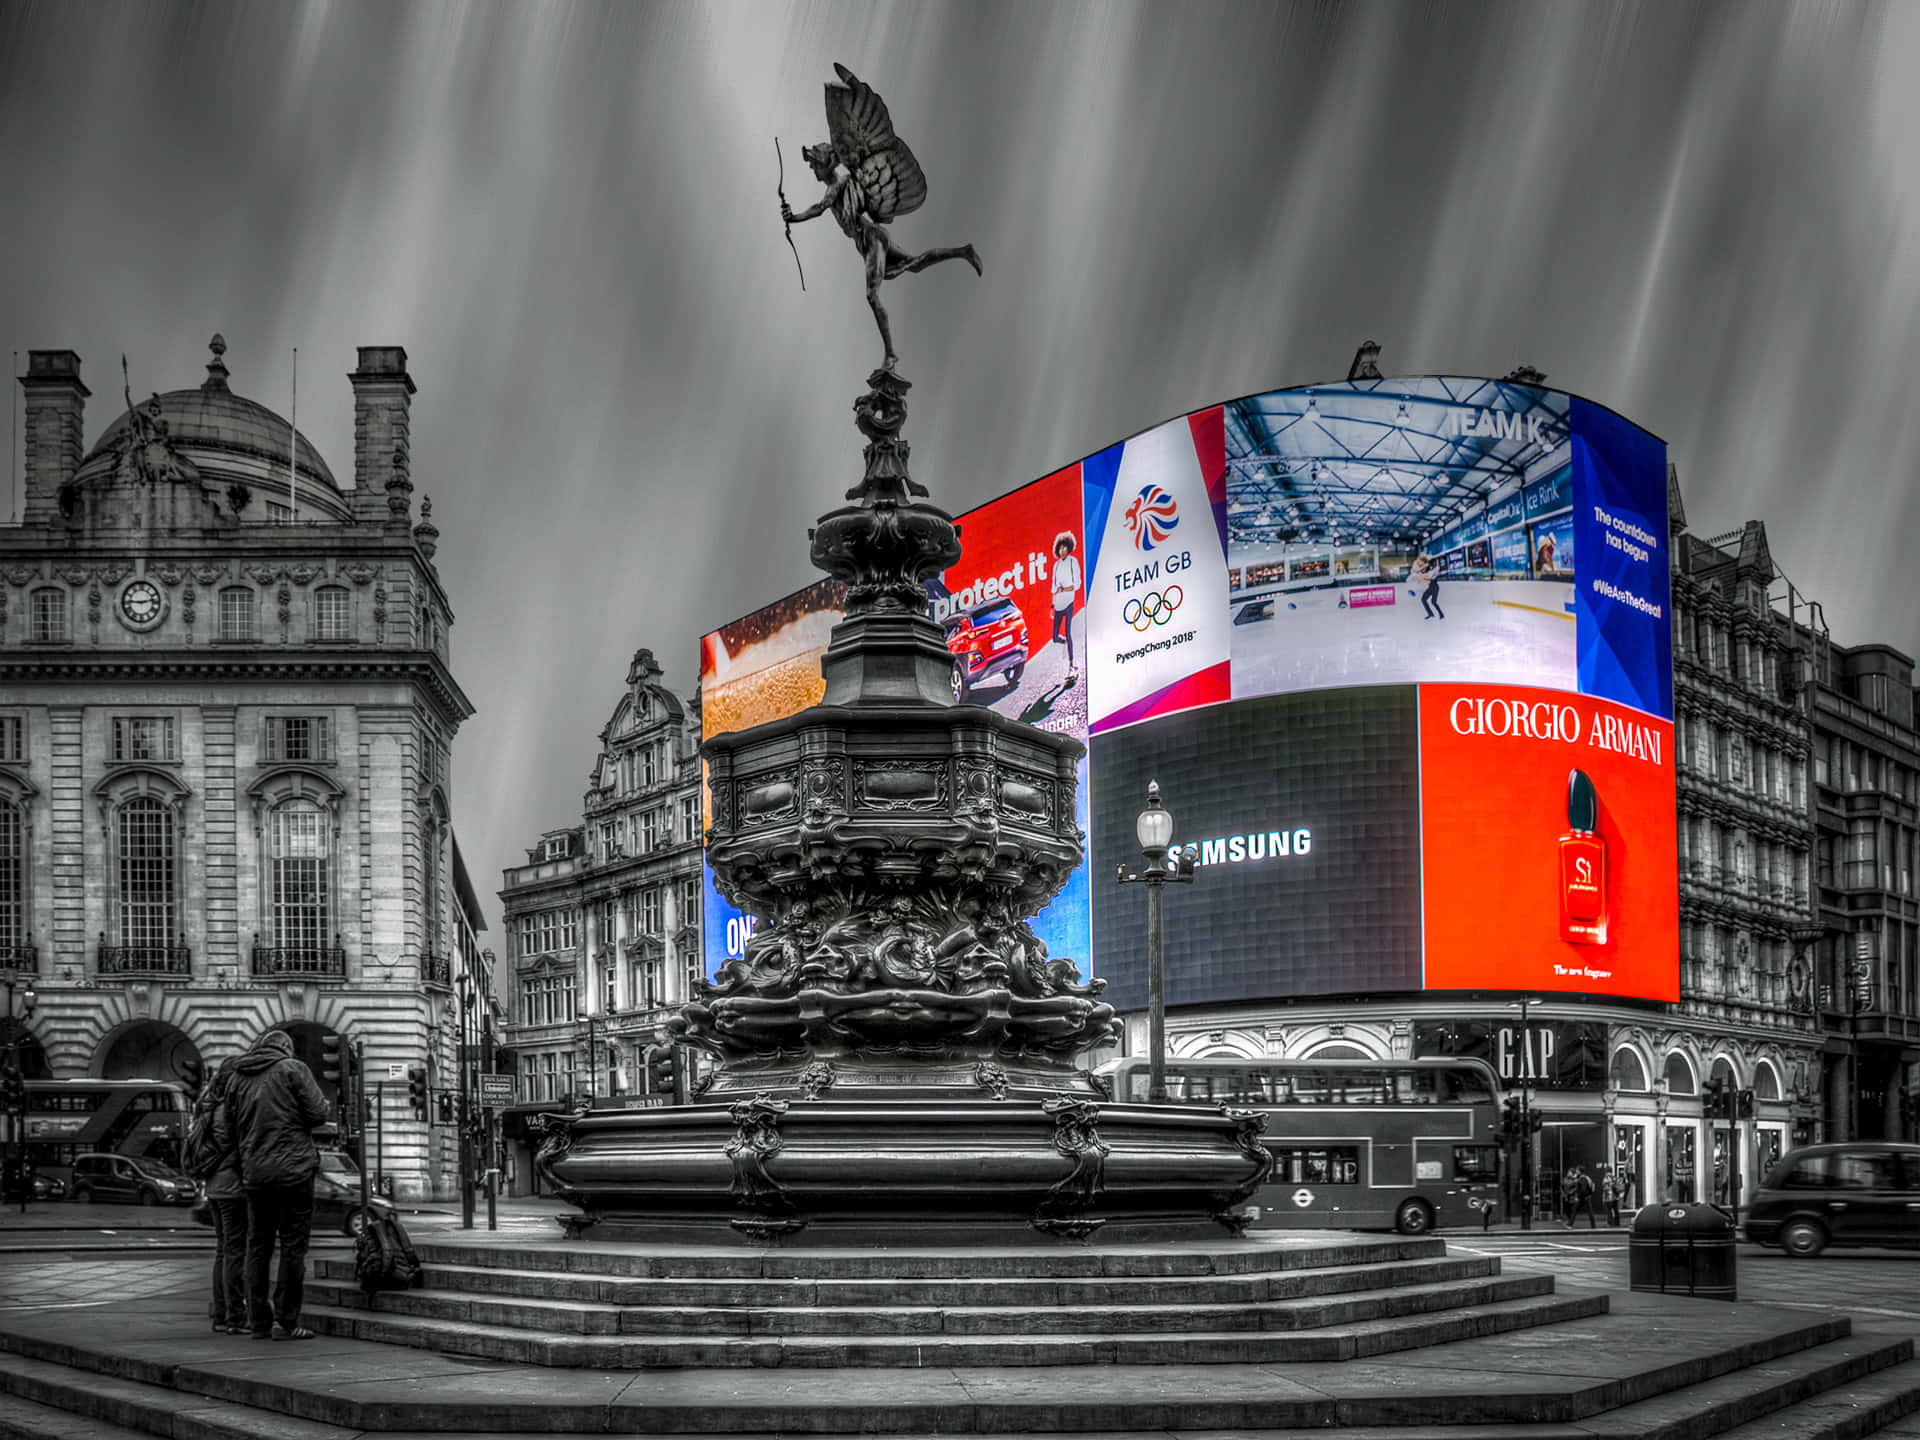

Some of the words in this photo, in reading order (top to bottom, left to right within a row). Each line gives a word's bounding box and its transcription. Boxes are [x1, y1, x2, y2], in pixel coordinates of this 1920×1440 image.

[1447, 408, 1522, 441] TEAM
[1539, 480, 1560, 504] Rink
[1594, 506, 1612, 526] The
[1613, 517, 1657, 548] countdown
[1606, 530, 1622, 550] has
[1623, 537, 1649, 563] begun
[934, 561, 1024, 625] protect
[1029, 552, 1048, 585] it
[1115, 560, 1159, 593] TEAM
[1165, 551, 1192, 574] GB
[1593, 579, 1662, 619] #WeAreTheGreat
[1116, 639, 1172, 664] PyeongChang
[1450, 697, 1581, 743] GIORGIO
[1588, 711, 1662, 766] ARMANI
[1553, 964, 1568, 976] The
[1498, 1027, 1555, 1079] GAP
